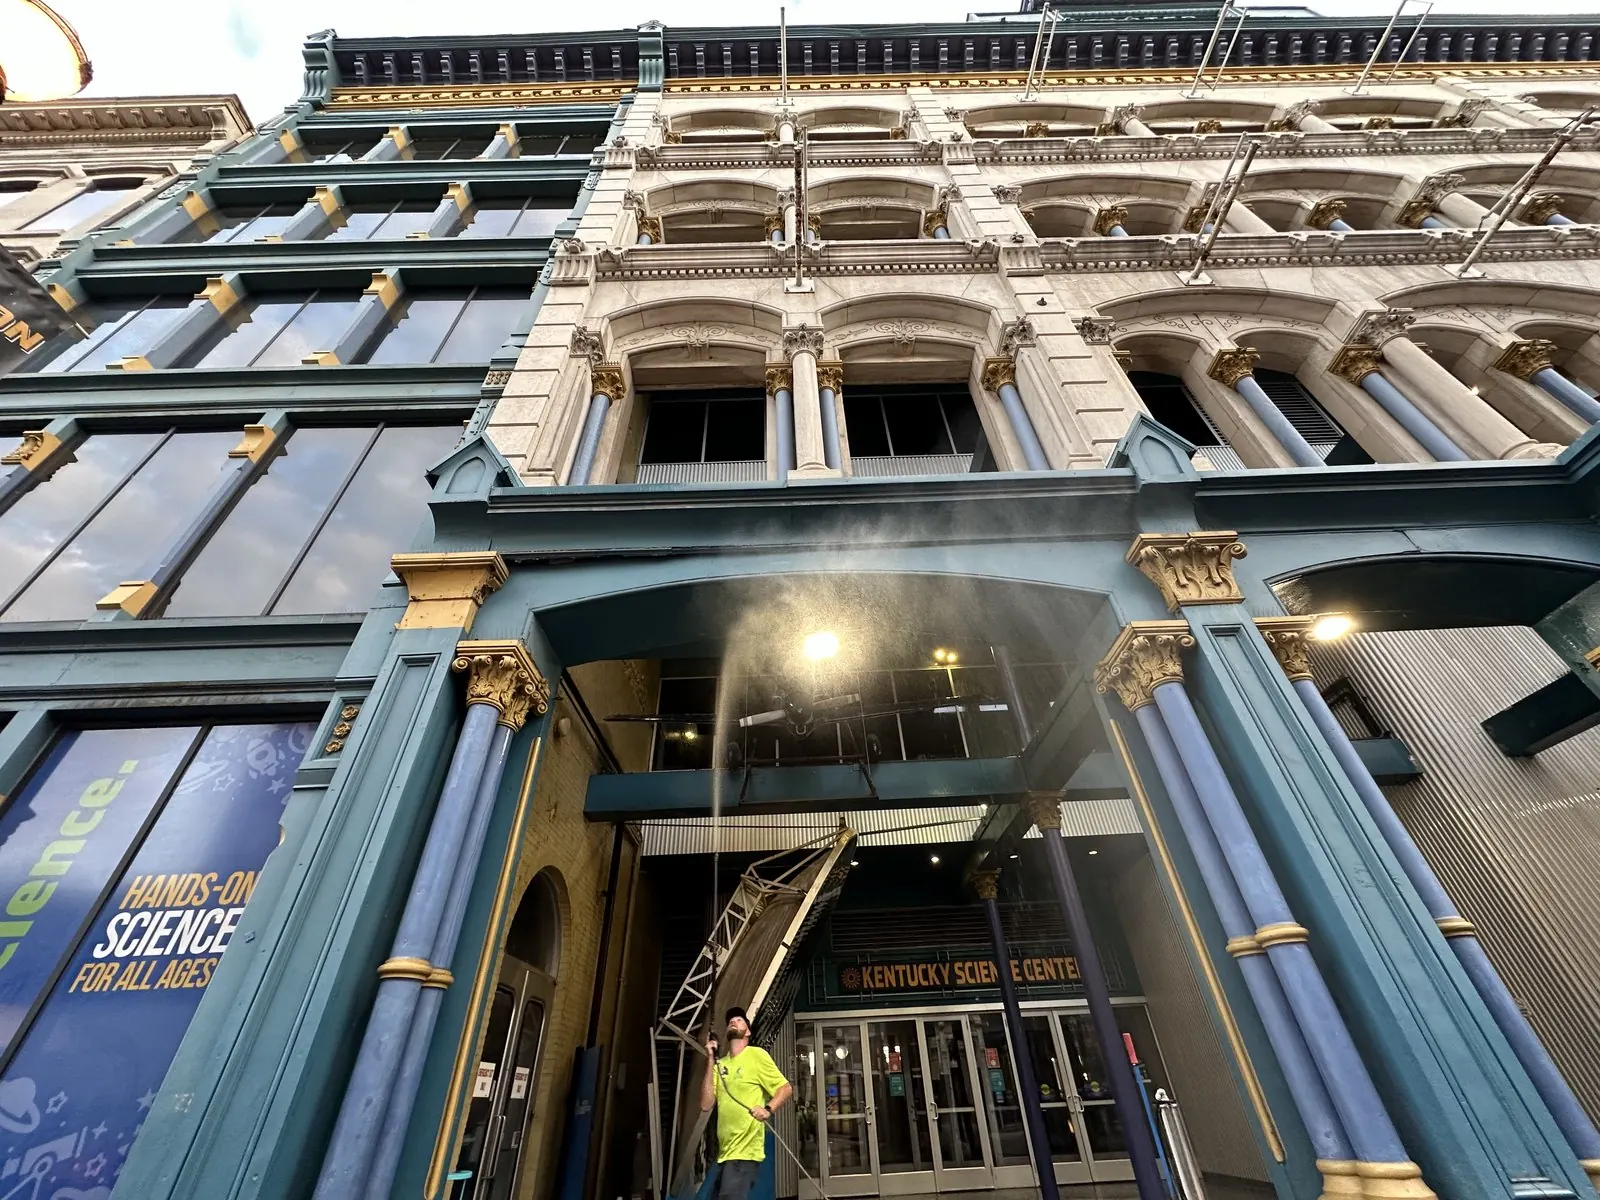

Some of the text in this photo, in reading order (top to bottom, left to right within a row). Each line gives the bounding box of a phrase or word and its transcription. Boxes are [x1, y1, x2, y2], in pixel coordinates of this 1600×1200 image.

[119, 871, 260, 910] HANDS-ON
[93, 908, 245, 959] SCIENCE
[68, 958, 217, 993] FOR ALL AGES
[862, 957, 1081, 989] KENTUCKY SCIENE CENTE
